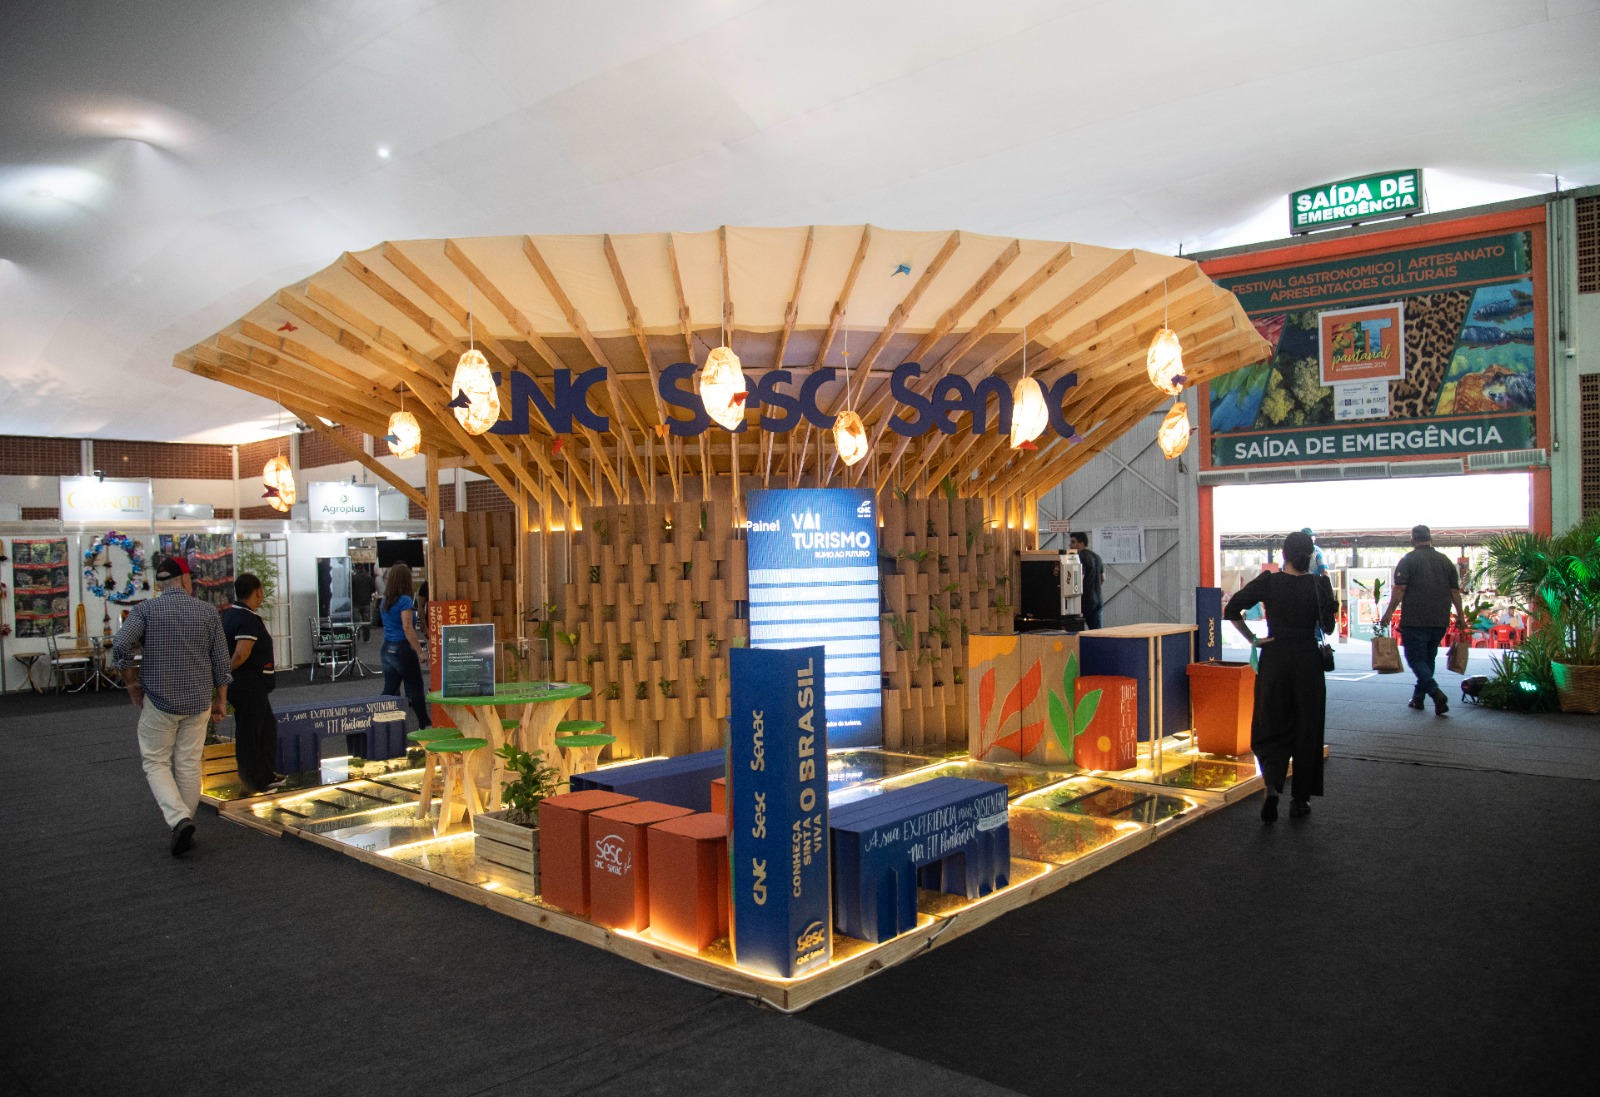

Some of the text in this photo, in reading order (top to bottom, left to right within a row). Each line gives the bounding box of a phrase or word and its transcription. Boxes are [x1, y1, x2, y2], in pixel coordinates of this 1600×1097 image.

[1297, 175, 1415, 212] SAÍDA DE
[1297, 194, 1415, 225] EMERGÊNCIA
[1231, 245, 1505, 295] FESTIVAL GASTRONOMICO ARTESANATO
[1381, 266, 1458, 287] CULTURAIS
[1331, 343, 1391, 371] pantanal
[1234, 425, 1504, 460] SAÍDA DE EMERGÊNCIA
[322, 504, 365, 515] Agroplus
[792, 507, 820, 531] VAI
[746, 519, 780, 532] Painel
[792, 531, 871, 550] TURISMO
[814, 551, 834, 559] RUMO
[845, 550, 871, 558] FUTURO
[448, 605, 457, 626] OM
[1207, 617, 1215, 648] Senac
[1121, 684, 1136, 701] 100%
[277, 713, 290, 724] A
[1120, 700, 1131, 714] RE
[797, 657, 817, 812] O BRASIL
[750, 710, 767, 906] CNC Sesc Senac
[803, 817, 812, 866] SINTA
[814, 813, 822, 853] VIVA
[865, 830, 879, 851] A
[879, 827, 901, 848] sua
[907, 821, 976, 863] na FIT Pantanal
[595, 839, 623, 866] Sesc
[793, 819, 802, 898] CONHEÇA
[797, 925, 825, 951] Sesc
